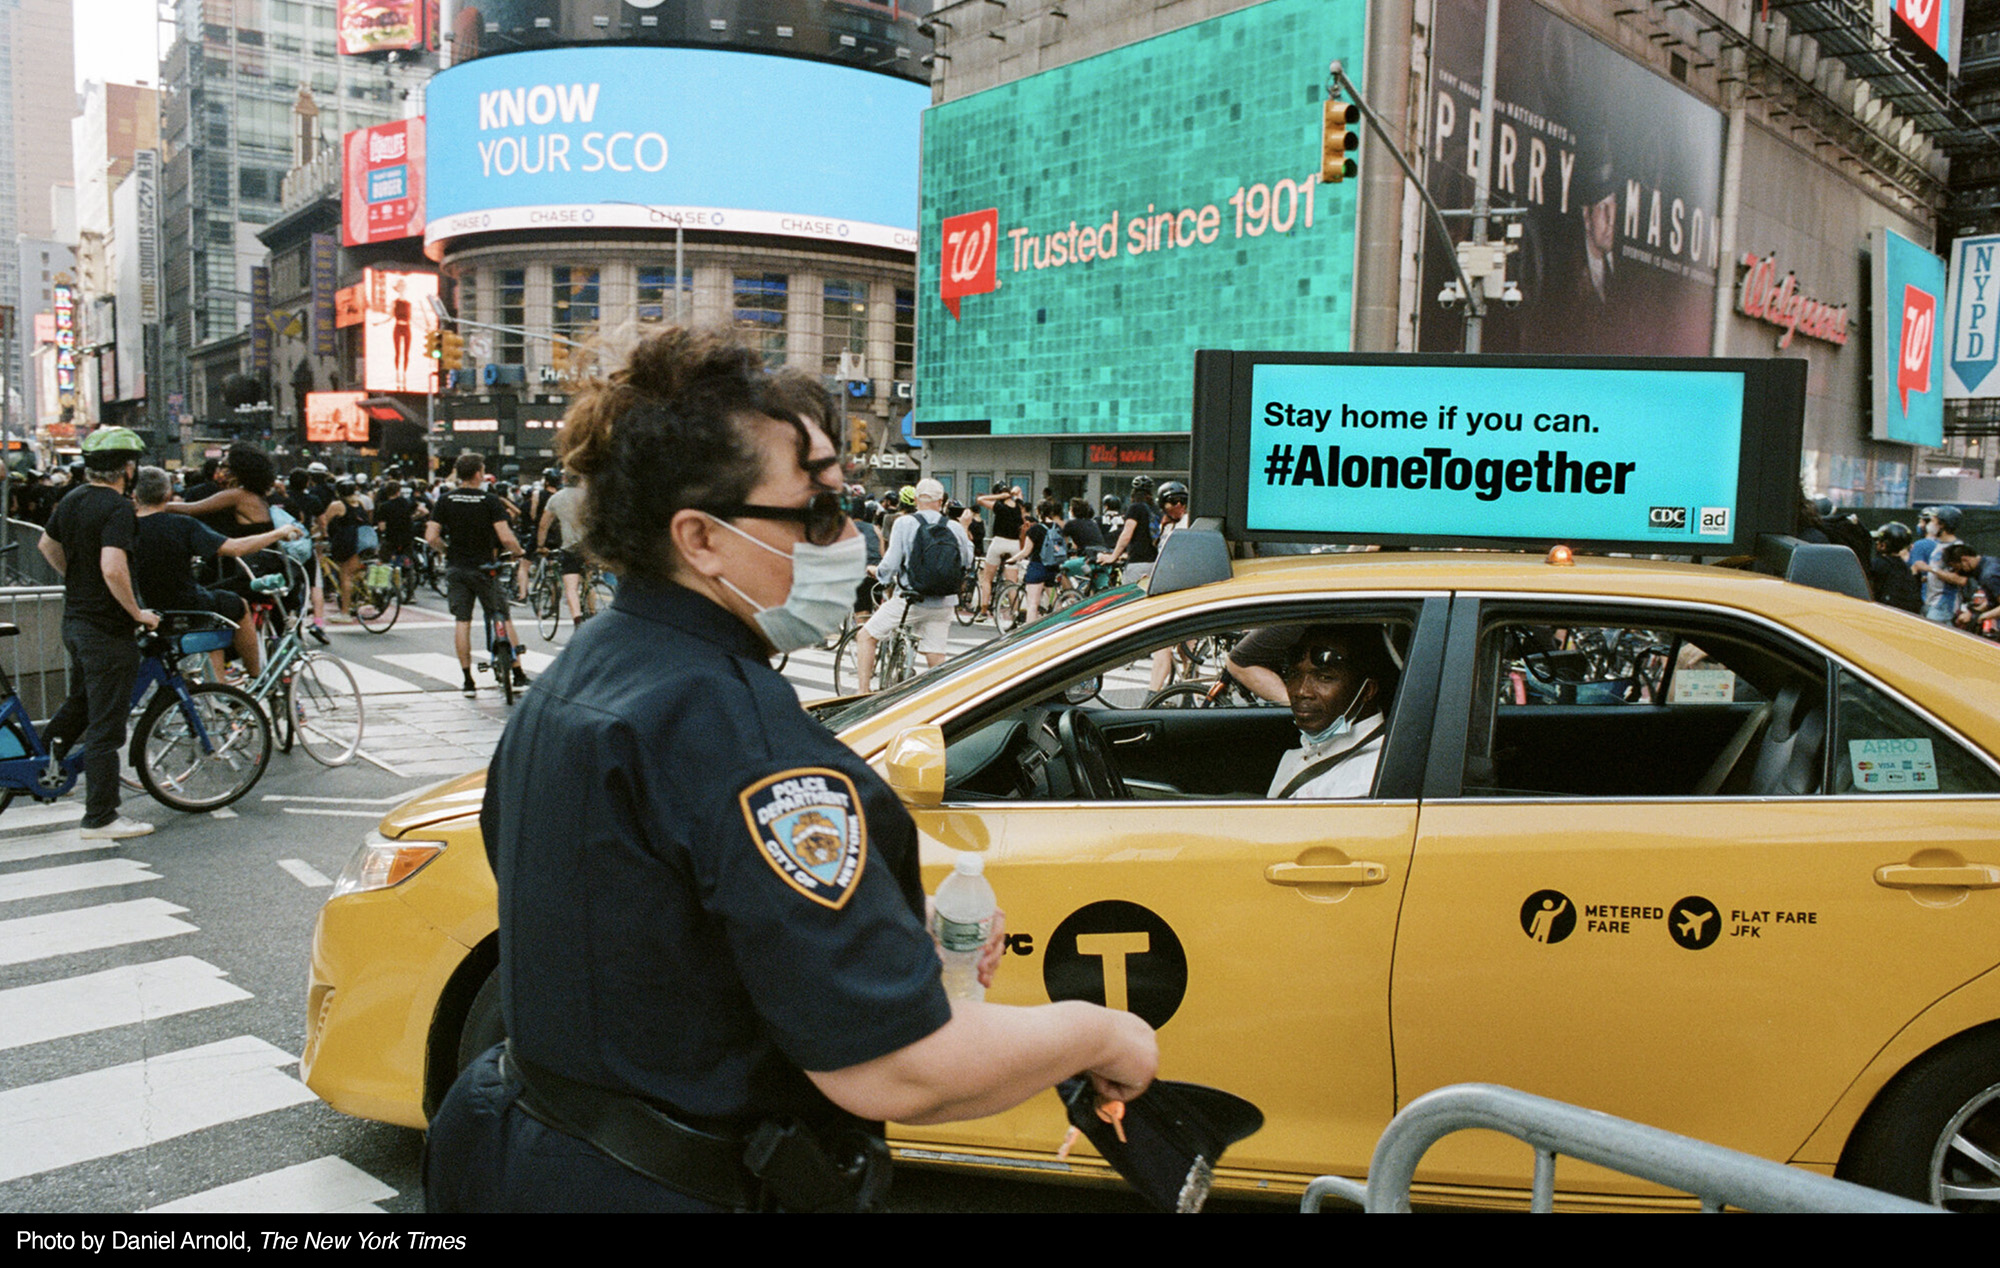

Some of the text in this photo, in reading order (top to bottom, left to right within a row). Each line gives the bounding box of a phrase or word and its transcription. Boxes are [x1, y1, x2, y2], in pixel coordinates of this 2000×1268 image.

[478, 83, 601, 131] KNOW
[477, 131, 669, 178] YOUR SCO
[1435, 91, 1576, 213] PERRY
[1624, 179, 1719, 269] MASON
[452, 216, 480, 231] CHASE
[530, 210, 578, 224] CHASE
[649, 207, 706, 226] CHASE
[781, 218, 834, 235] CHASE
[1007, 210, 1119, 273] Trusted
[1126, 203, 1221, 256] since
[1738, 252, 1848, 349] Walgreens
[1966, 246, 1994, 359] NYPD
[55, 288, 75, 390] REGAL
[1263, 402, 1600, 436] Stay home if you can.
[853, 453, 907, 469] HASE
[1263, 443, 1636, 502] #AloneTogether
[1651, 508, 1726, 526] CDC ad
[771, 776, 829, 801] POLICE
[757, 790, 849, 826] DEPARTMENT
[765, 840, 818, 888] CITY OF
[836, 814, 860, 888] NEW YORK
[1585, 904, 1664, 920] METERED
[1588, 920, 1631, 934] FARE
[1731, 910, 1817, 924] FLAT FARE
[1730, 925, 1761, 938] JFK
